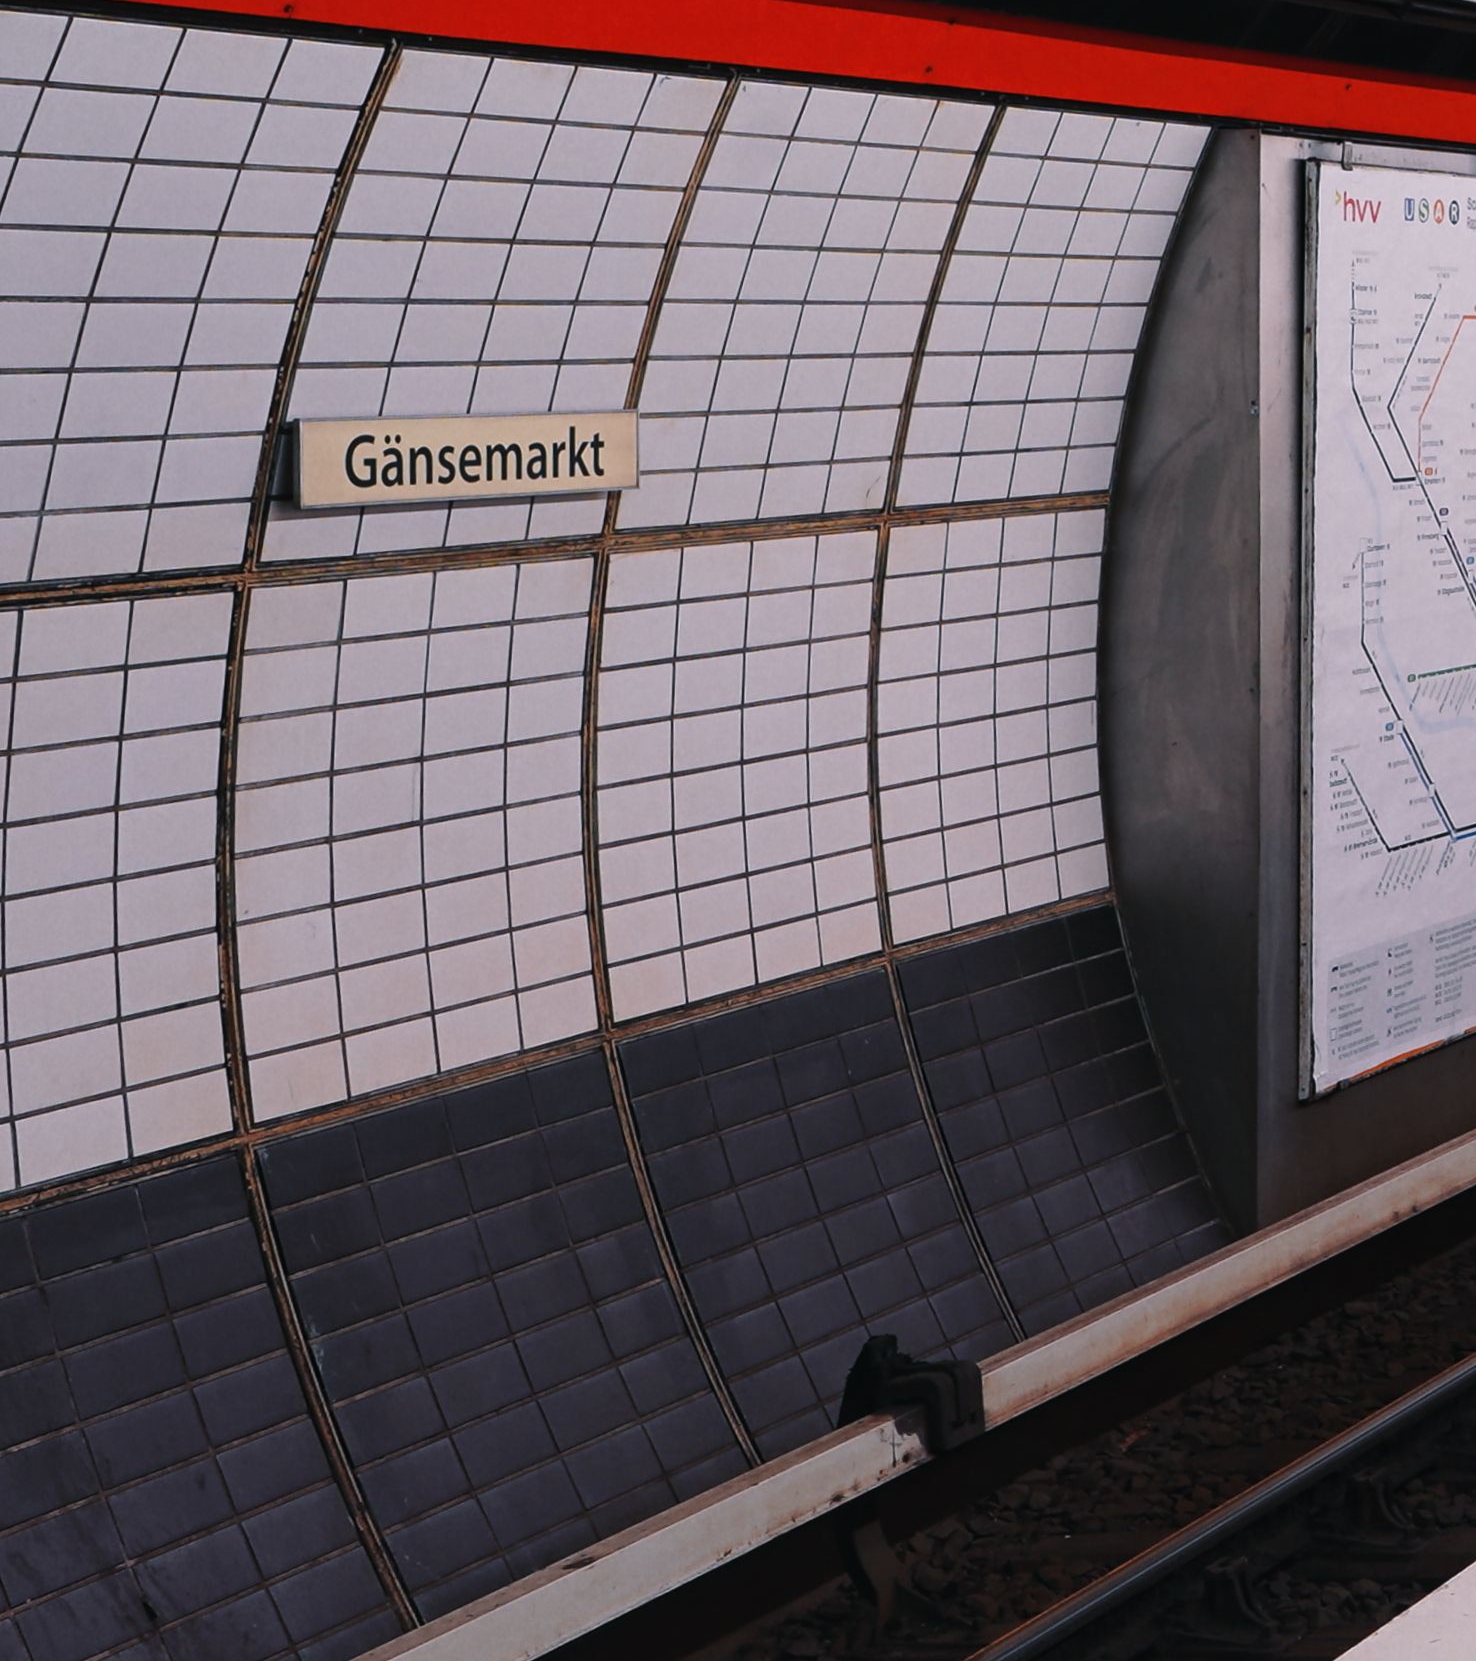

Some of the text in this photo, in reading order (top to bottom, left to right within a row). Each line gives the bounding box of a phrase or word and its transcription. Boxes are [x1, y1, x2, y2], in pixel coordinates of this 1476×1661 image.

[1343, 191, 1382, 224] hvv
[1404, 198, 1416, 222] U
[1419, 198, 1430, 224] S
[1449, 200, 1460, 225] R
[344, 425, 606, 489] Gänsemarkt
